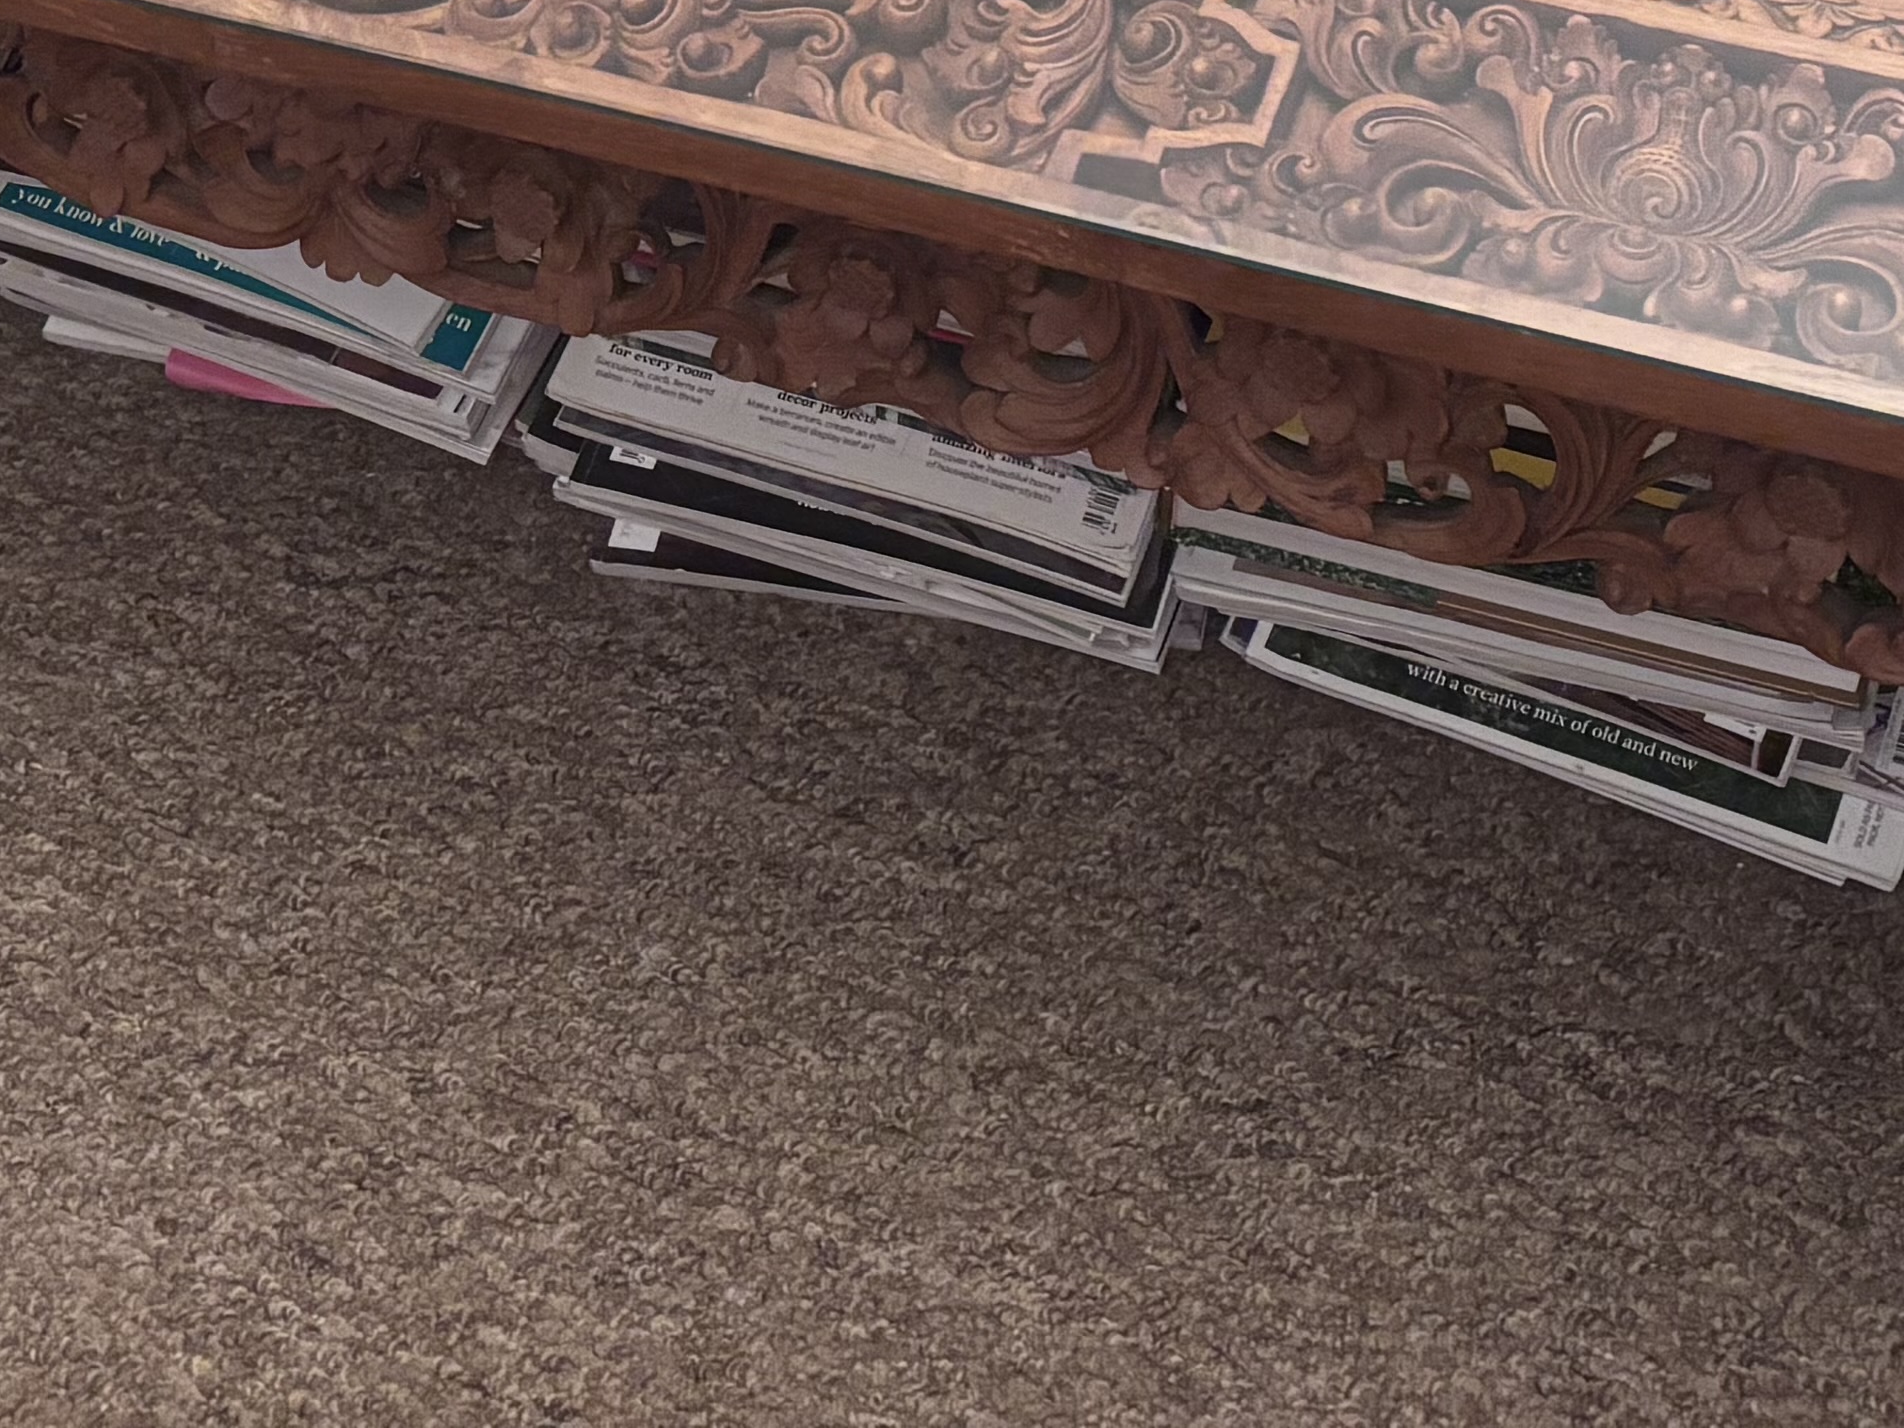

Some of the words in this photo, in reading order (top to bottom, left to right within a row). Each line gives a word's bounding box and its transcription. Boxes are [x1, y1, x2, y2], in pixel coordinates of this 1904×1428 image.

[11, 188, 52, 210] you
[54, 197, 103, 227] know
[608, 343, 632, 358] for
[634, 353, 674, 372] every
[676, 363, 714, 381] room
[777, 390, 817, 409] decor
[819, 401, 877, 425] projects
[1407, 663, 1446, 686] with
[1449, 678, 1459, 691] a
[1463, 683, 1532, 715] creative
[1533, 706, 1569, 727] mix
[1570, 719, 1592, 734] of
[1592, 726, 1620, 744] old
[1622, 737, 1657, 757] and
[1659, 749, 1698, 770] new
